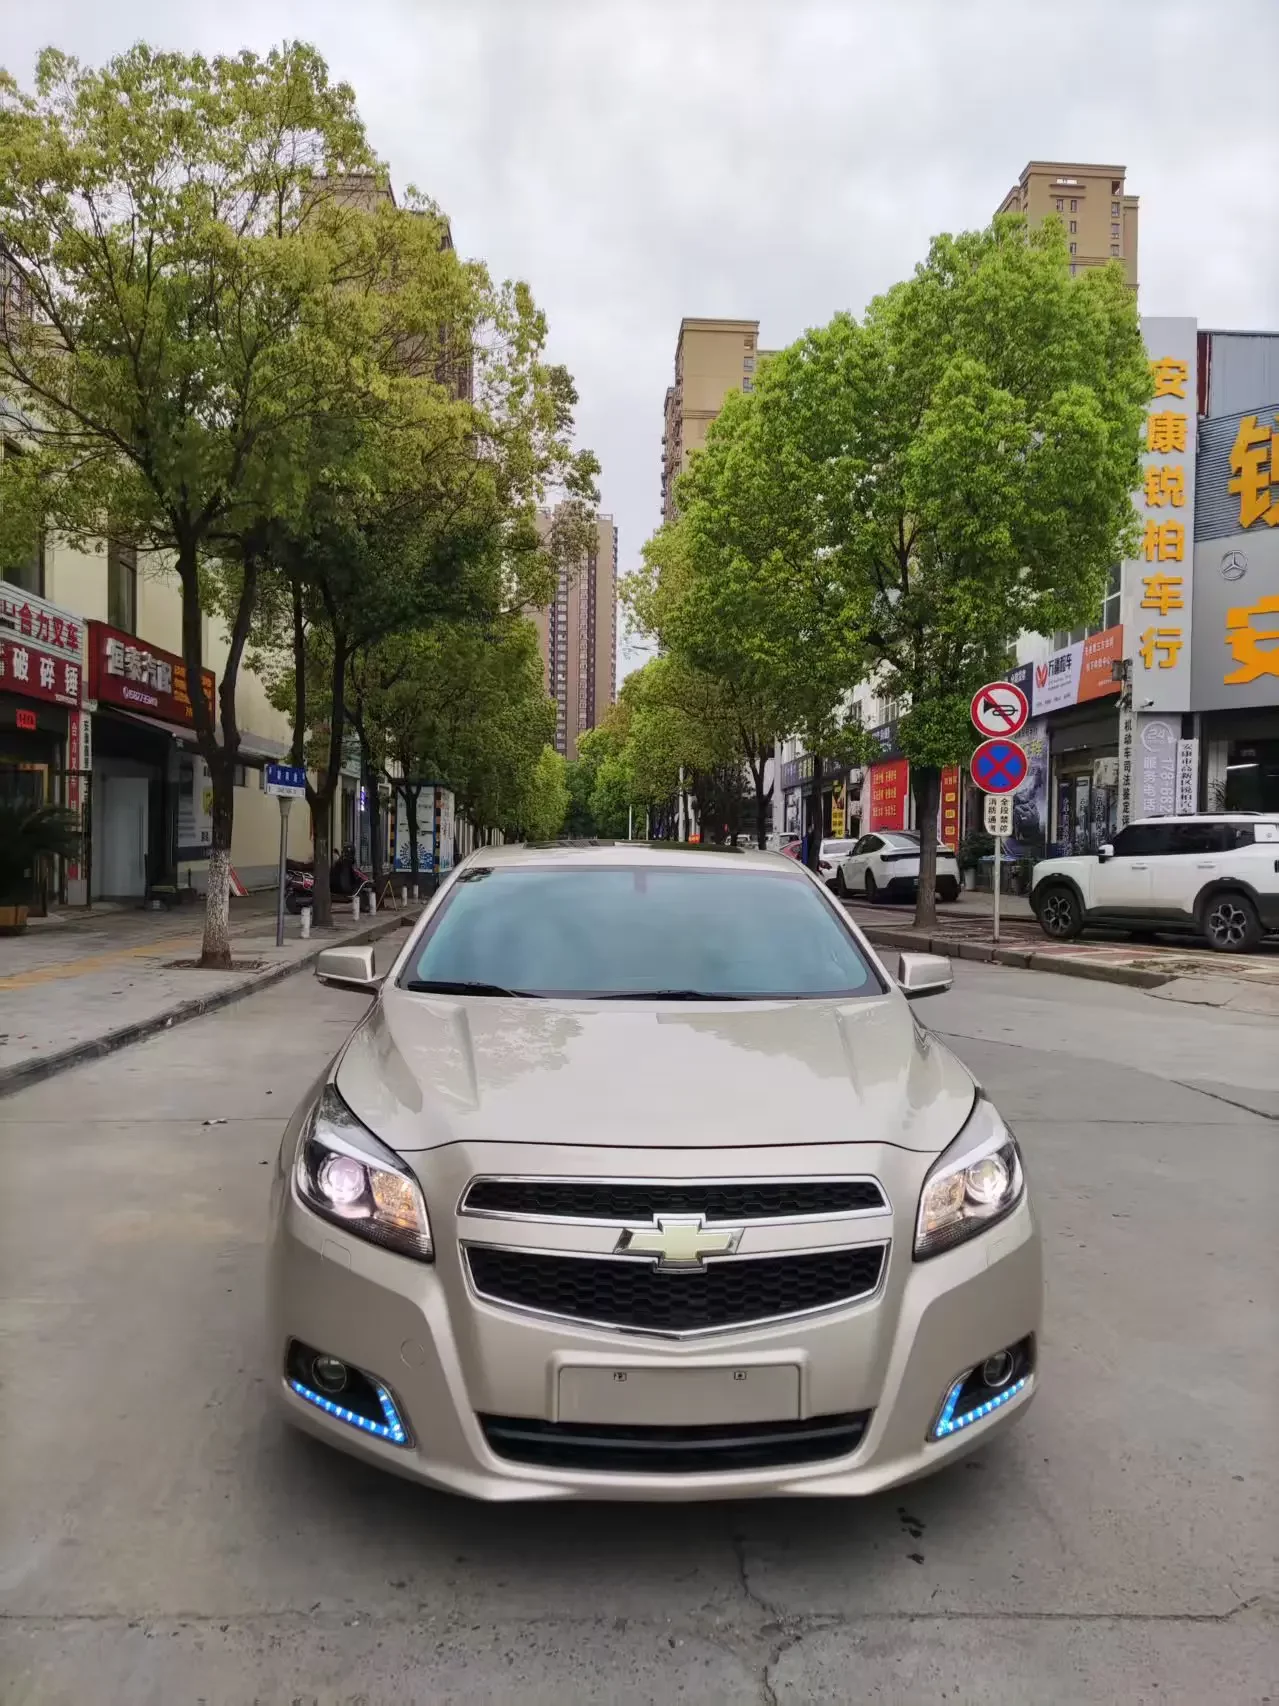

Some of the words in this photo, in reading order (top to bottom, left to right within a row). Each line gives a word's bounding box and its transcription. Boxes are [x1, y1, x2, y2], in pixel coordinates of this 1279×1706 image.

[1139, 356, 1189, 669] 安康锐柏车行
[19, 602, 79, 652] 合力叉车
[1000, 798, 1009, 833] 全段禁停
